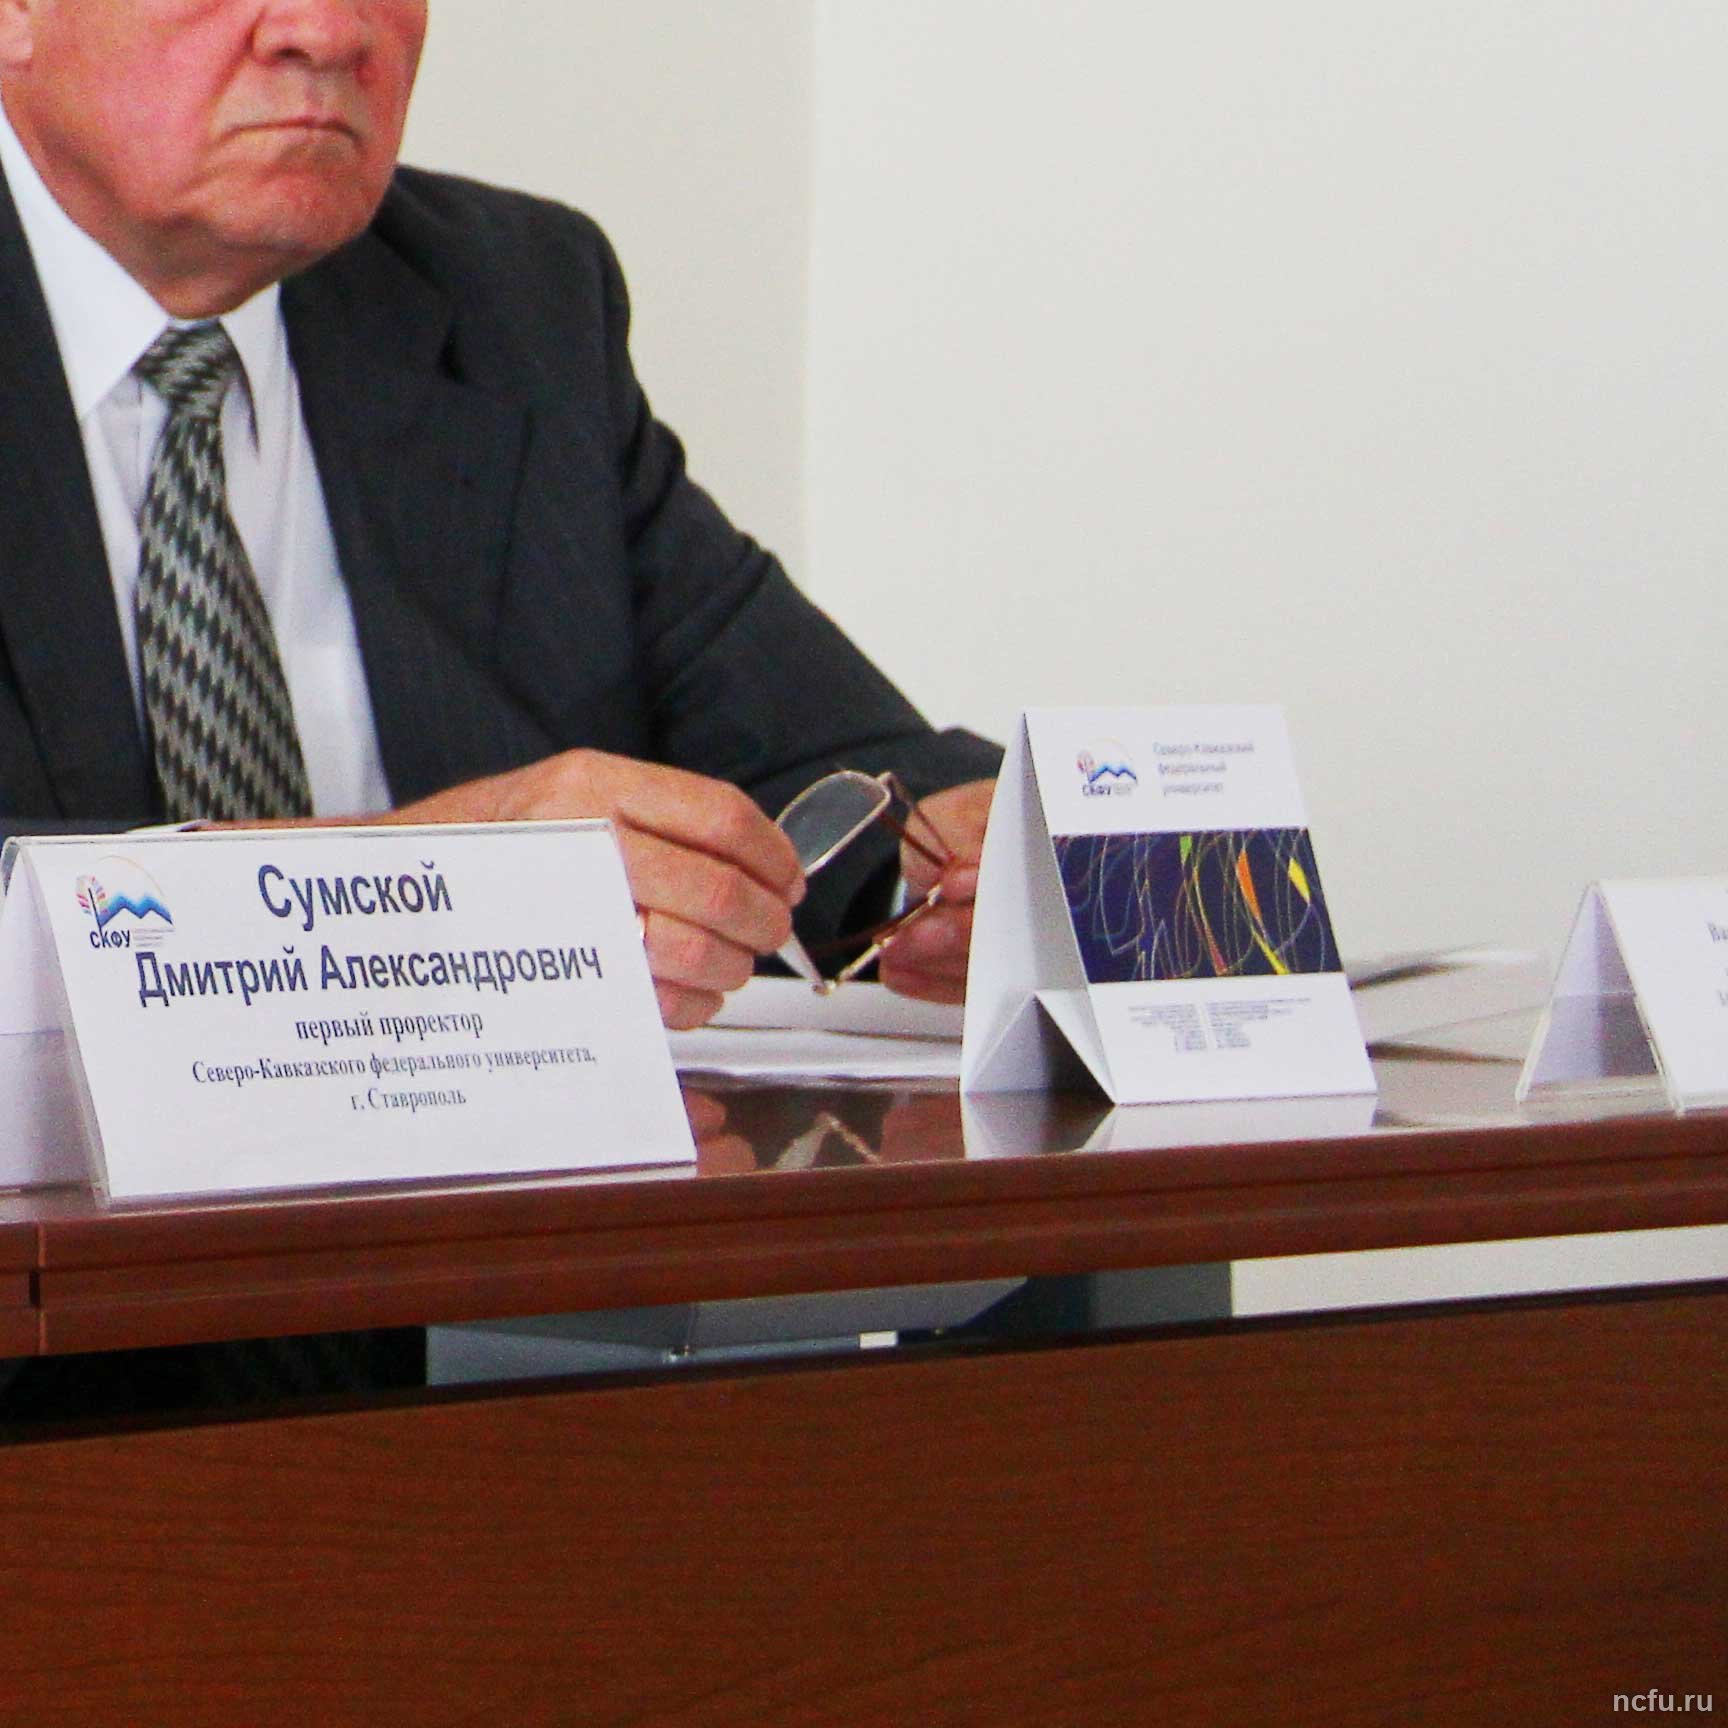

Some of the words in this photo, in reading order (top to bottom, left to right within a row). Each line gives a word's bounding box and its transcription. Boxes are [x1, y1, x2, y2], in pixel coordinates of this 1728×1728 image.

[258, 861, 452, 932] Сумской
[90, 928, 131, 949] СКФУ
[135, 945, 308, 1008] Дмитрий
[321, 944, 603, 994] Александрович
[295, 1011, 374, 1045] первый
[380, 1013, 483, 1042] проректор
[192, 1058, 366, 1087] Северо-Кавказского
[370, 1052, 482, 1079] федерального
[351, 1095, 364, 1110] г.
[368, 1087, 466, 1112] Ставрополь
